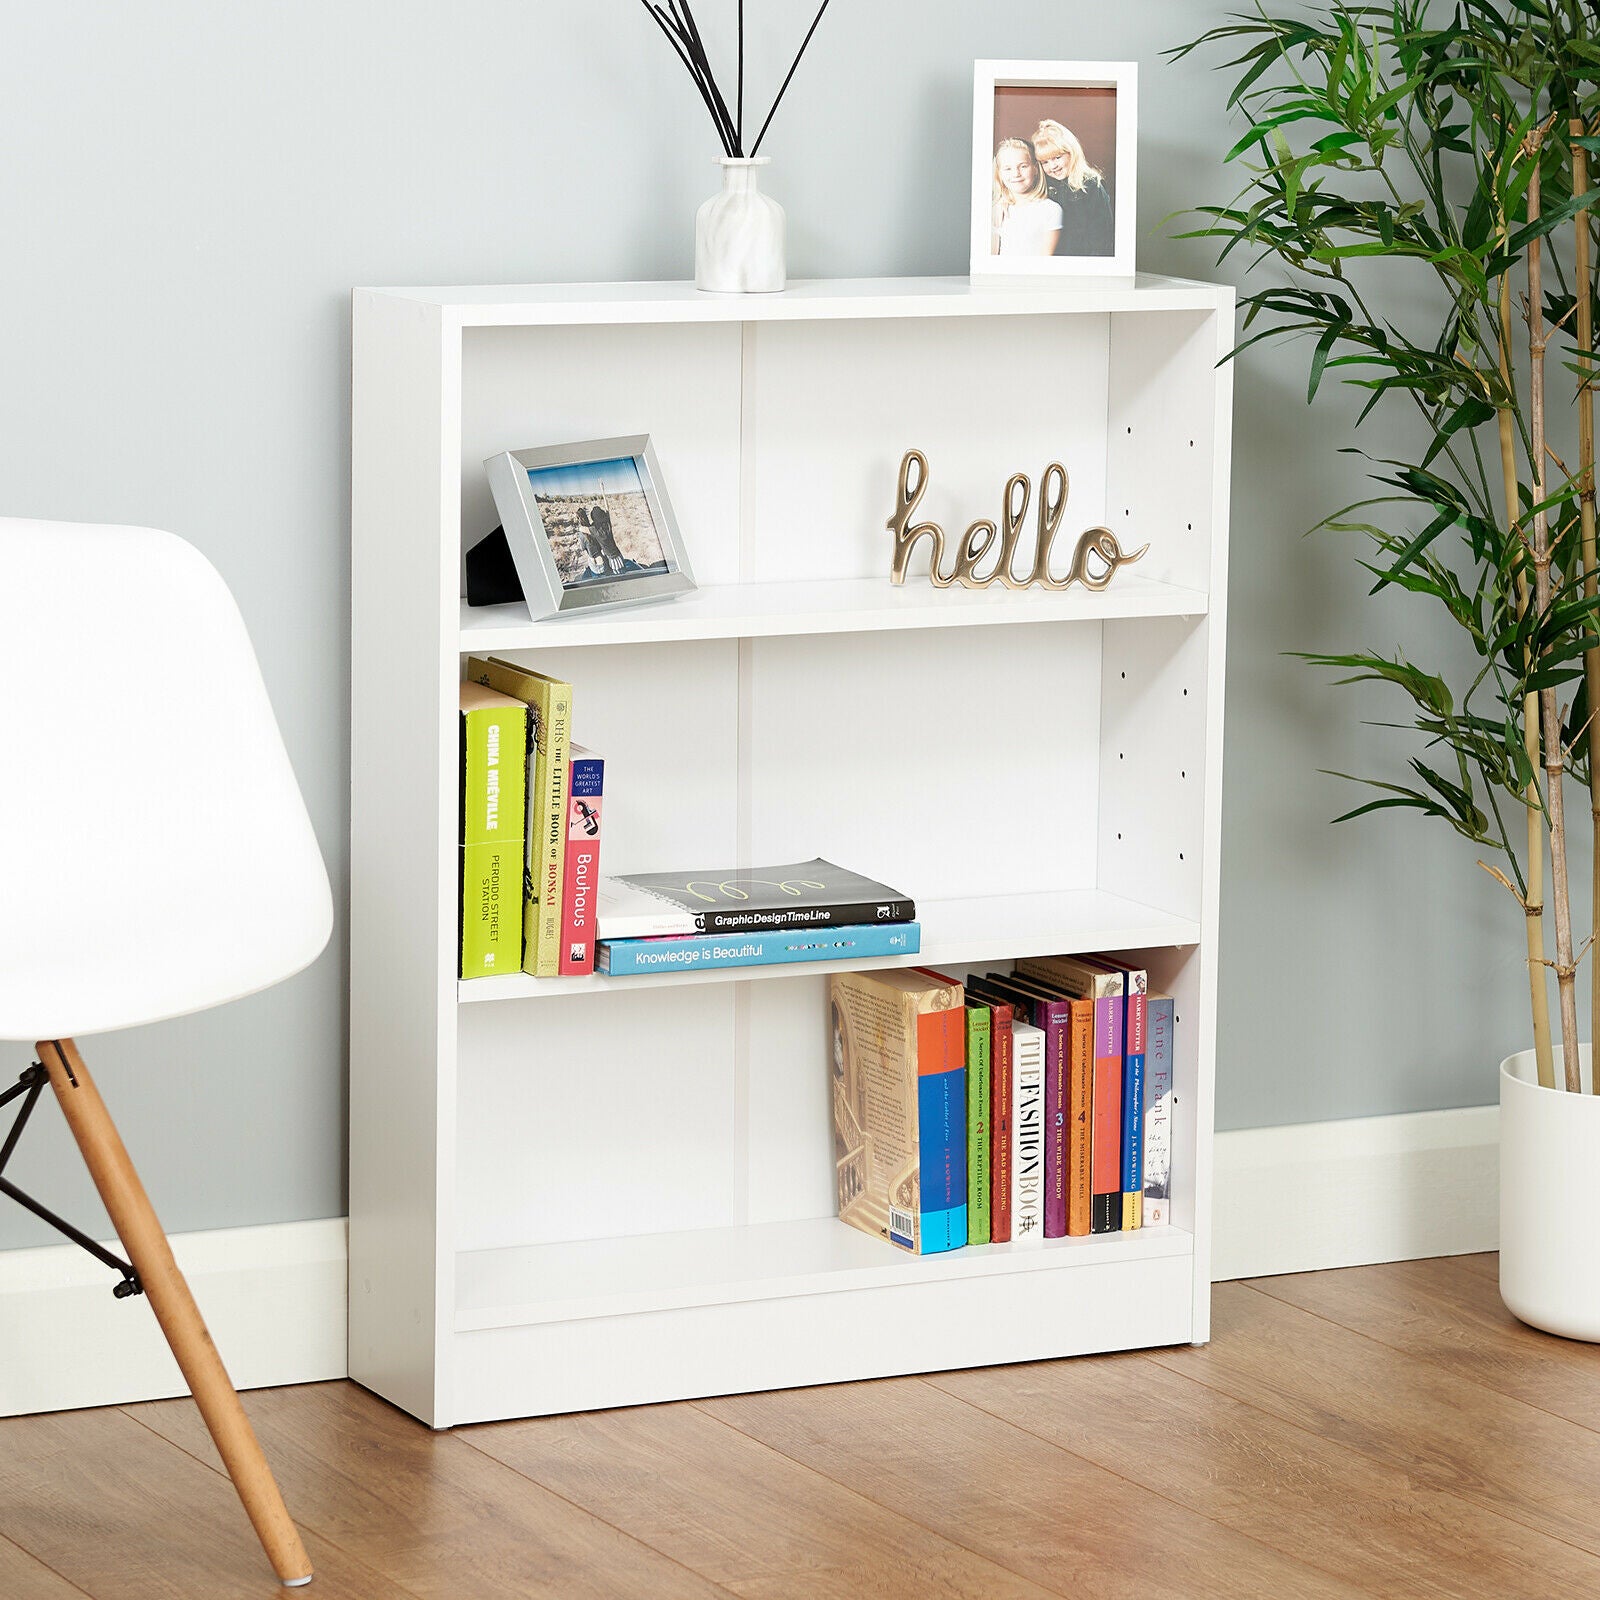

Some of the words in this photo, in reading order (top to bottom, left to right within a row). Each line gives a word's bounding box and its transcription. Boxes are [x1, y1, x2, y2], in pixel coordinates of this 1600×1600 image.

[885, 448, 1151, 591] hello
[487, 725, 500, 766] CHINA
[554, 719, 564, 743] RHS
[552, 768, 562, 810] LITTLE
[550, 814, 560, 844] BOOK
[551, 848, 557, 859] OF
[491, 855, 500, 901] PERDIDO
[547, 863, 557, 906] BONSAI
[573, 854, 592, 927] Bauhaus
[490, 903, 499, 942] STREET
[636, 950, 700, 964] Knowledge
[702, 948, 711, 959] is
[713, 944, 763, 958] Beautiful
[1155, 1011, 1168, 1060] Anne
[1055, 1112, 1064, 1126] 3
[1078, 1110, 1086, 1124] 4
[1154, 1072, 1168, 1125] Frank
